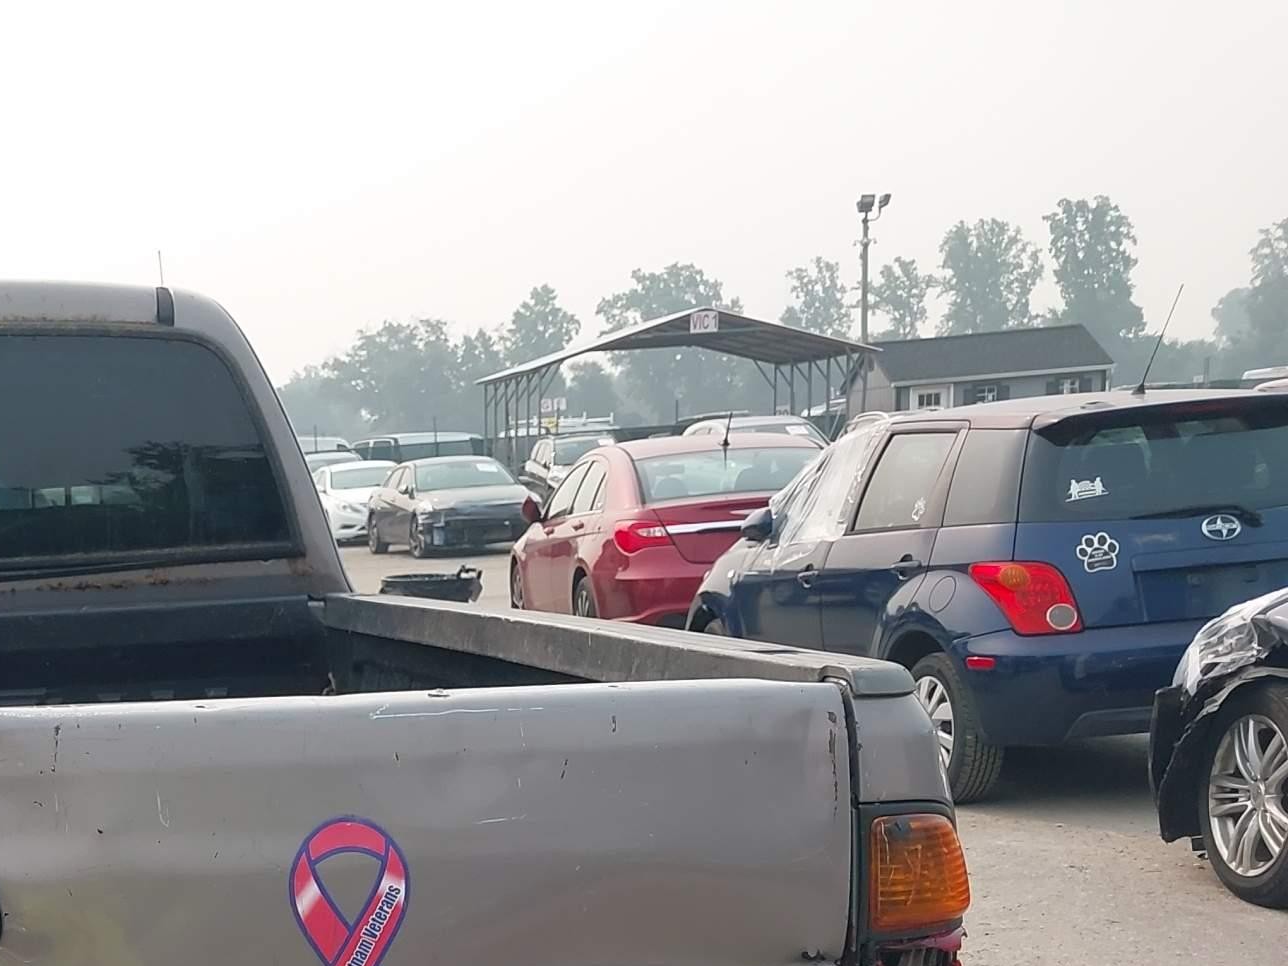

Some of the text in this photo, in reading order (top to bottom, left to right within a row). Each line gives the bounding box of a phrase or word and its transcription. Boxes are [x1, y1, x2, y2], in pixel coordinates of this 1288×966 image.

[691, 313, 717, 330] VIC 1
[363, 885, 401, 940] Veterans
